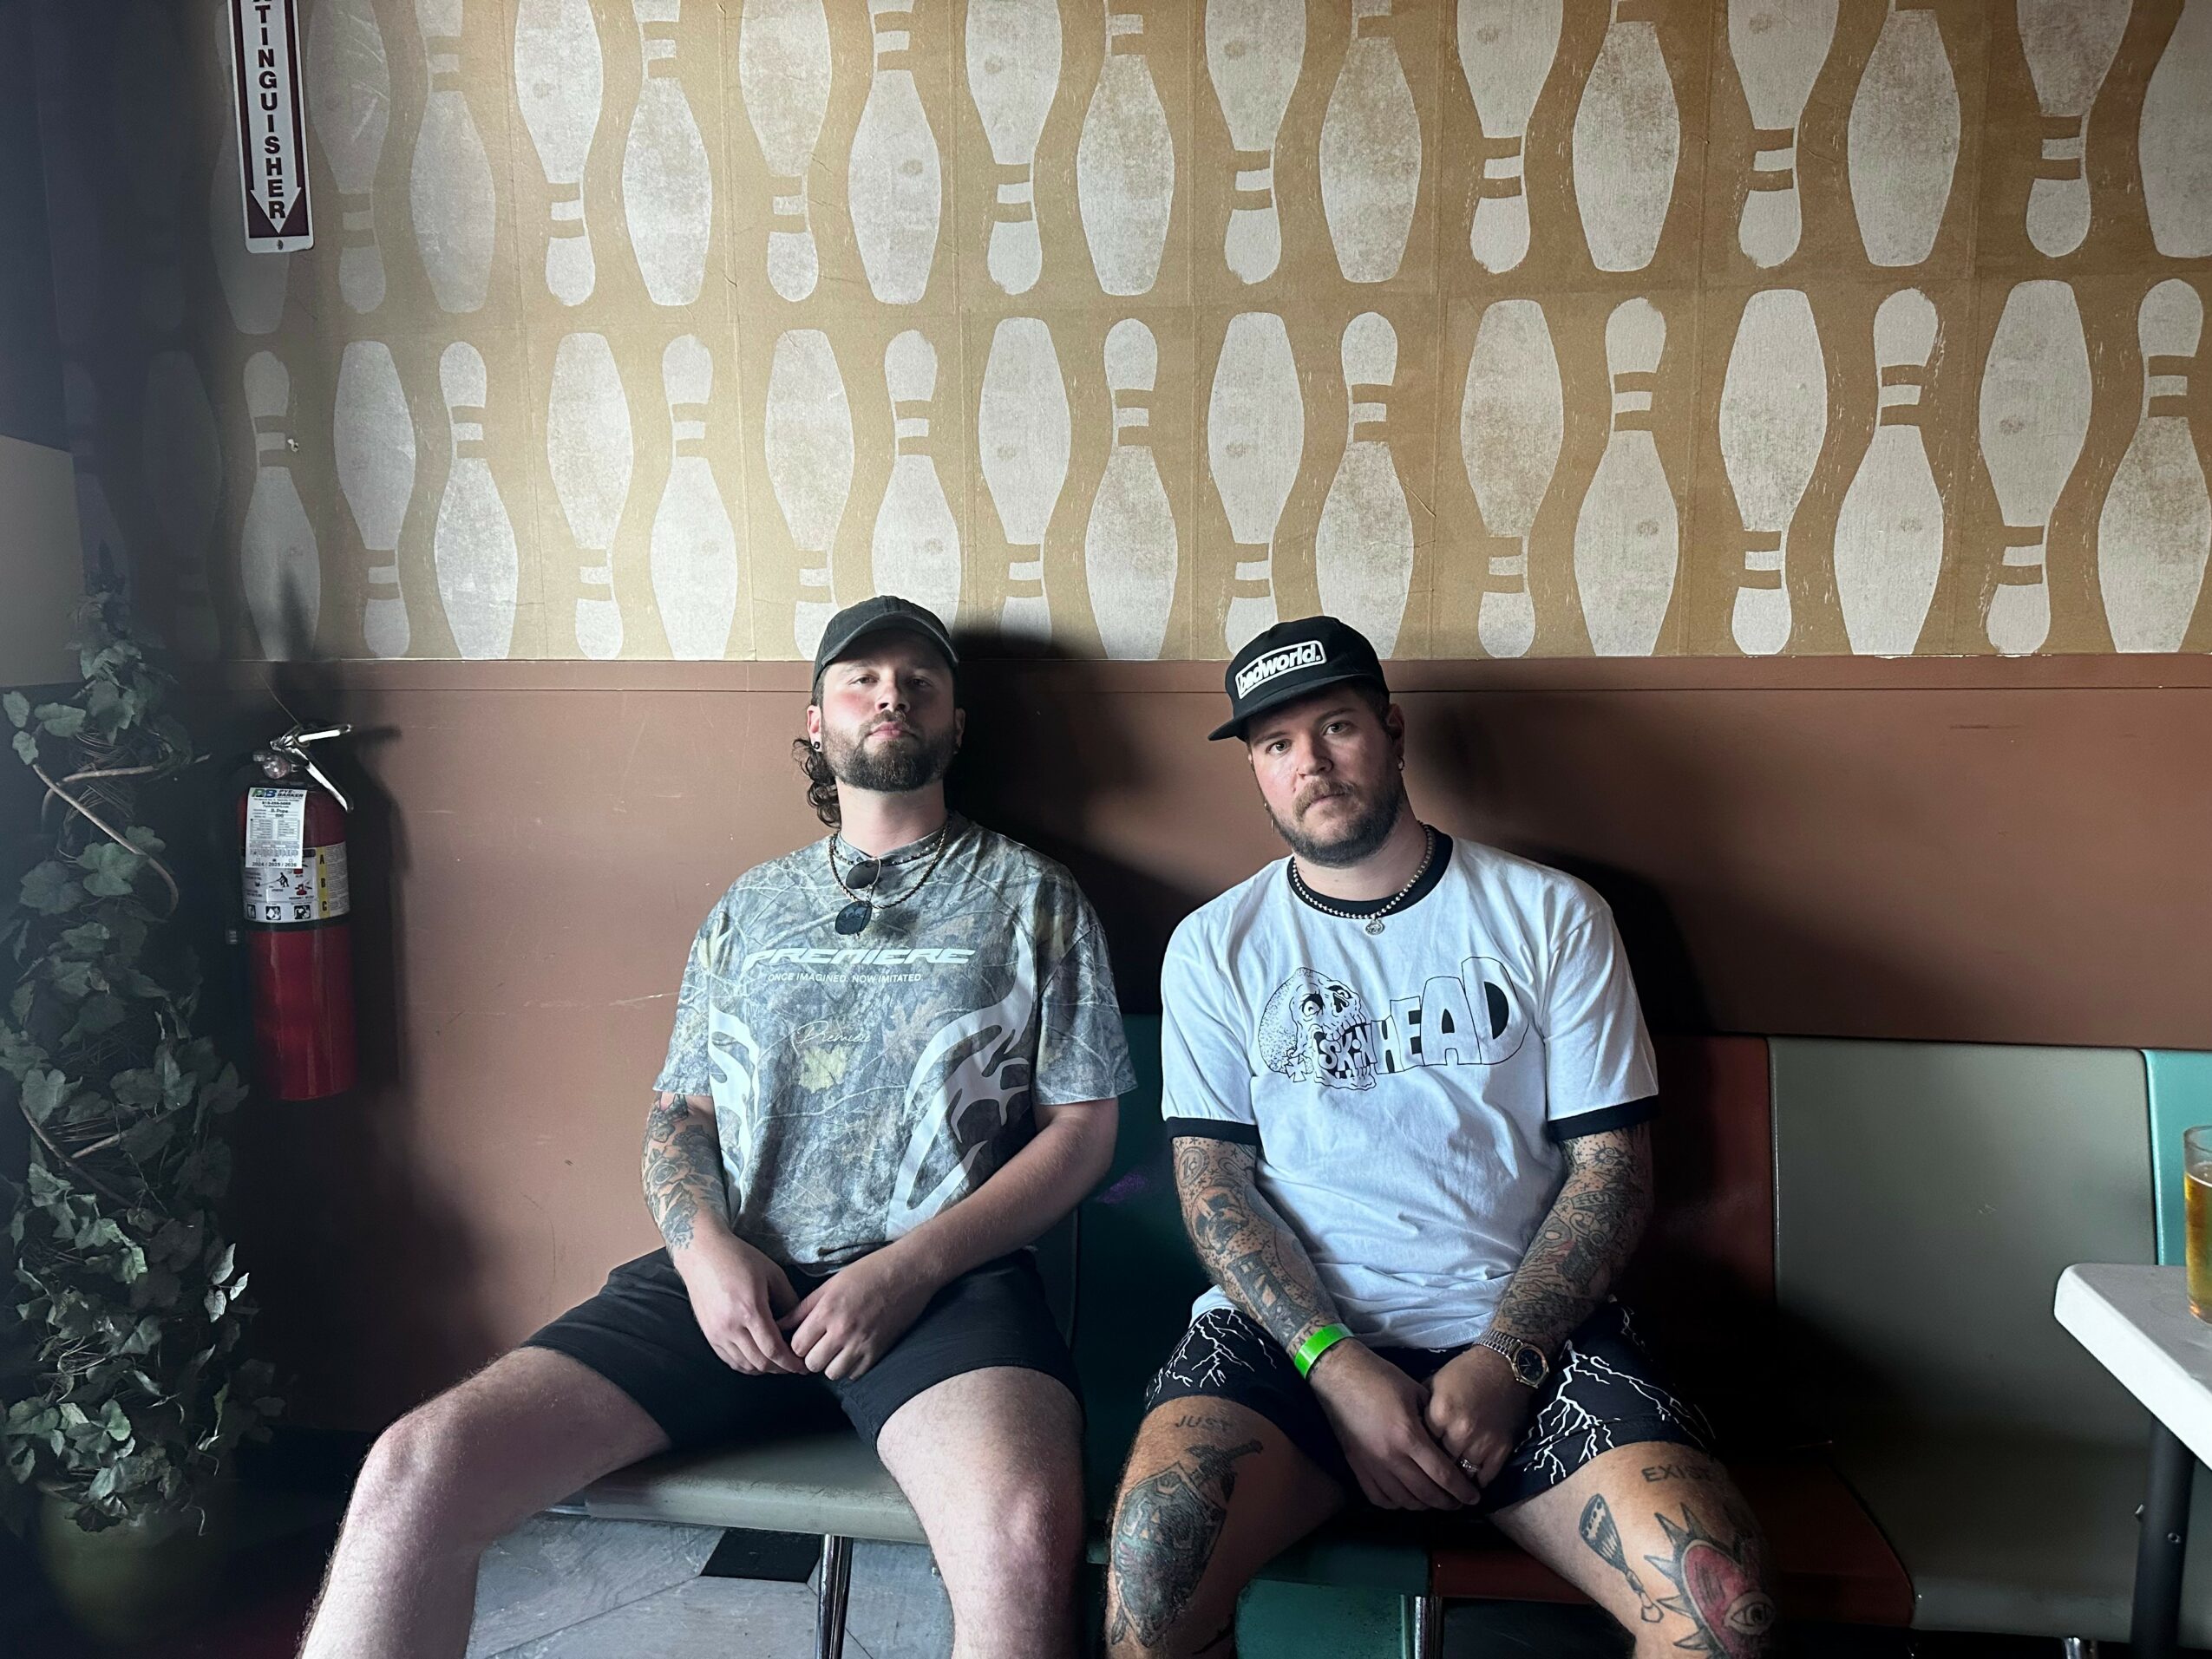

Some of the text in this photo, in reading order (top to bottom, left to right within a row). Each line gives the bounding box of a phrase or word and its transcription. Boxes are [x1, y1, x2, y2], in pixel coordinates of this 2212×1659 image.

[253, 0, 286, 219] TINGUISHER
[319, 854, 325, 865] A
[320, 878, 326, 888] B
[322, 901, 328, 911] C
[741, 947, 976, 974] PREMIERE
[768, 973, 794, 982] ONCE
[852, 975, 877, 983] NOW
